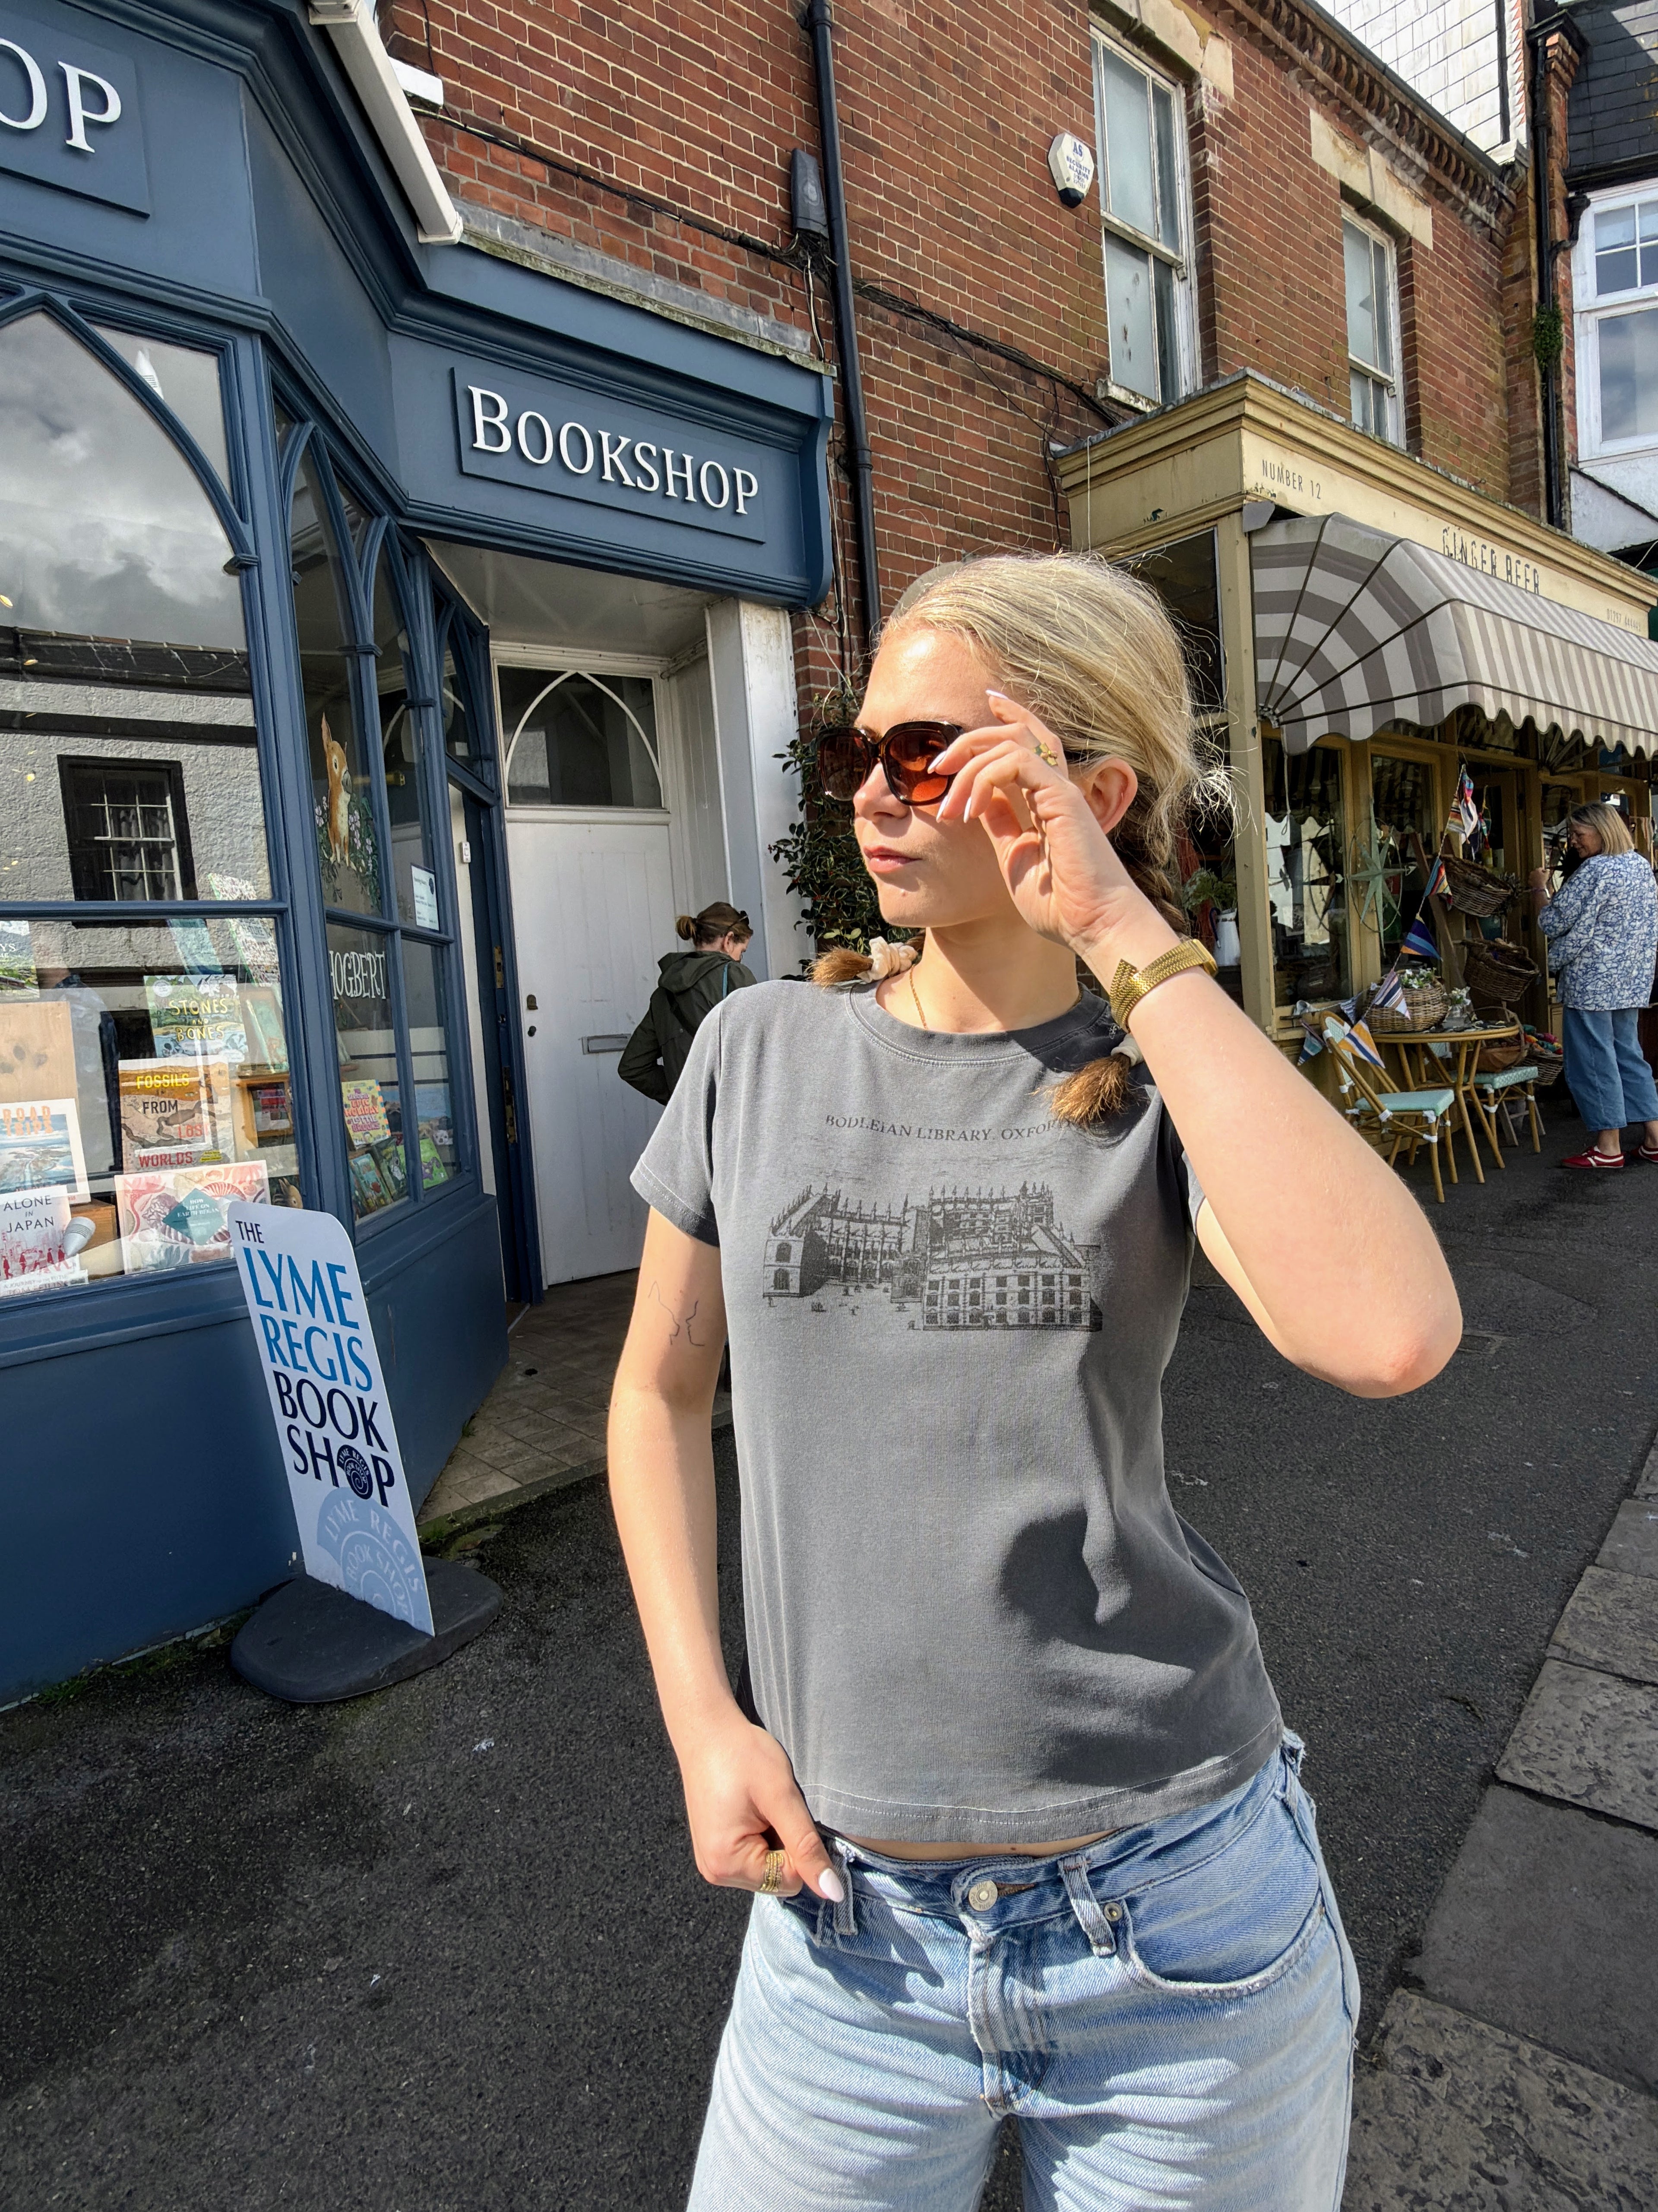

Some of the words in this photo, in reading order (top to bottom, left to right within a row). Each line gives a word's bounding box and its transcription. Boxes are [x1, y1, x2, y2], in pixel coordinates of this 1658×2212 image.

[1073, 141, 1082, 157] AS
[468, 385, 758, 515] BOOKSHOP
[1262, 459, 1303, 492] NUMBER
[1310, 479, 1321, 500] 12
[168, 998, 228, 1016] STONES
[175, 1025, 225, 1042] BONES
[136, 1073, 190, 1089] FOSSILS
[3, 1106, 51, 1124] ROAD
[143, 1100, 179, 1114] FROM
[5, 1120, 54, 1137] TRIPS
[177, 1123, 209, 1138] LOST
[825, 1115, 912, 1138] BODLEIAN
[1001, 1119, 1067, 1140] OXFOR
[139, 1151, 193, 1168] WORLDS
[3, 1195, 52, 1211] ALONE
[6, 1216, 54, 1233] JAPAN
[235, 1220, 264, 1243] THE
[243, 1247, 360, 1330] LYME
[260, 1313, 372, 1391] REGIS
[273, 1370, 389, 1453] BOOK
[325, 1499, 359, 1543] LYME
[370, 1508, 423, 1593] REGIS
[346, 1544, 374, 1582] BOOK
